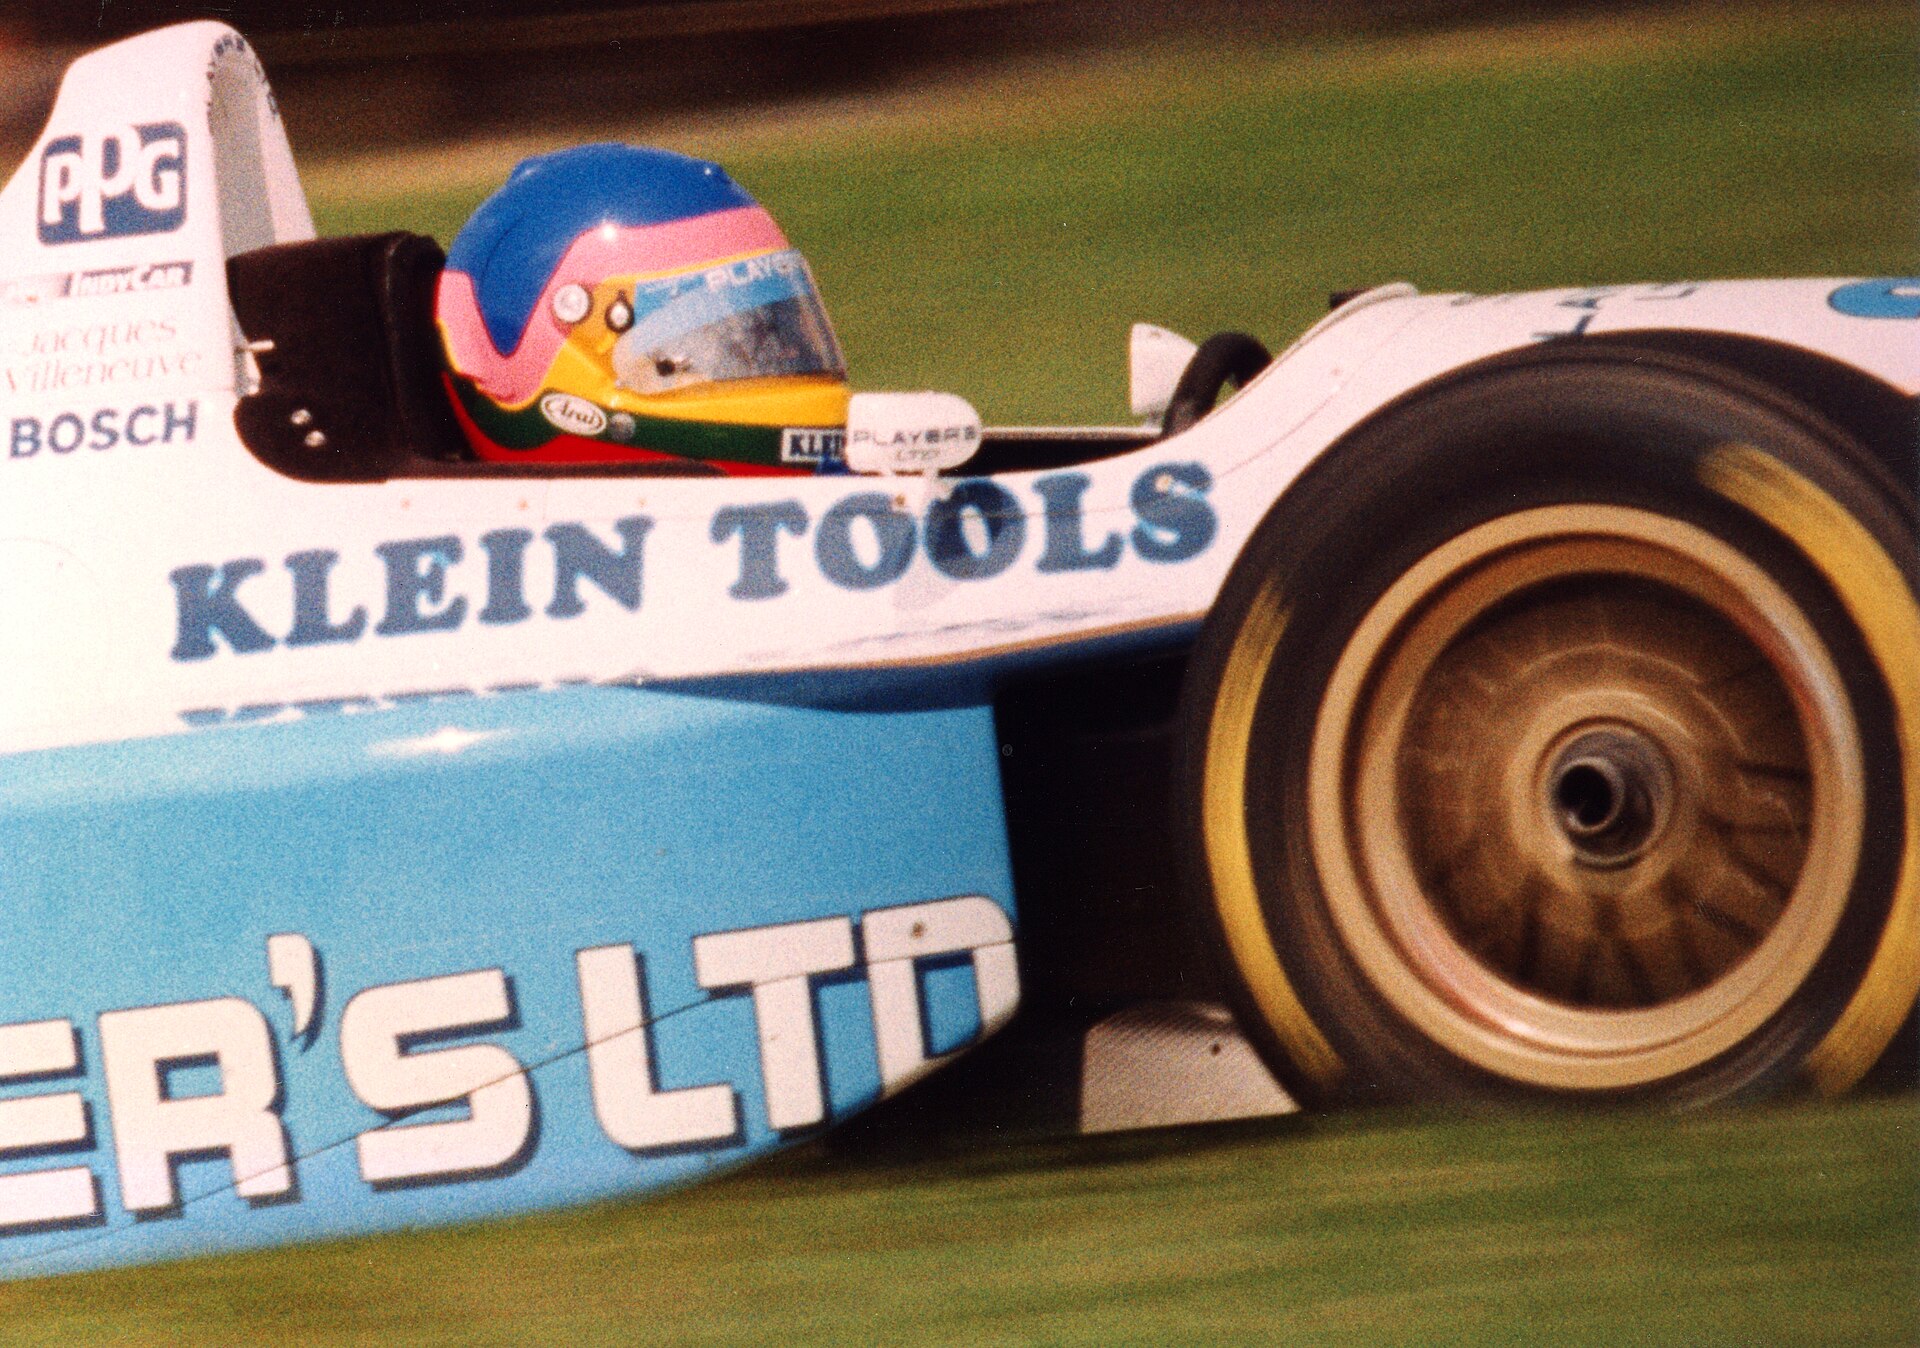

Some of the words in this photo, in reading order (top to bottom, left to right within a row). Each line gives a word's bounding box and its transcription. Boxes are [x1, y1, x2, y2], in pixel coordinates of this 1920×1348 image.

[42, 122, 182, 236] PPG
[9, 399, 198, 460] BOSCH
[544, 399, 605, 430] Arai
[168, 514, 655, 664] KLEIN
[709, 461, 1220, 601] TOOLS
[575, 895, 1022, 1156] LTD
